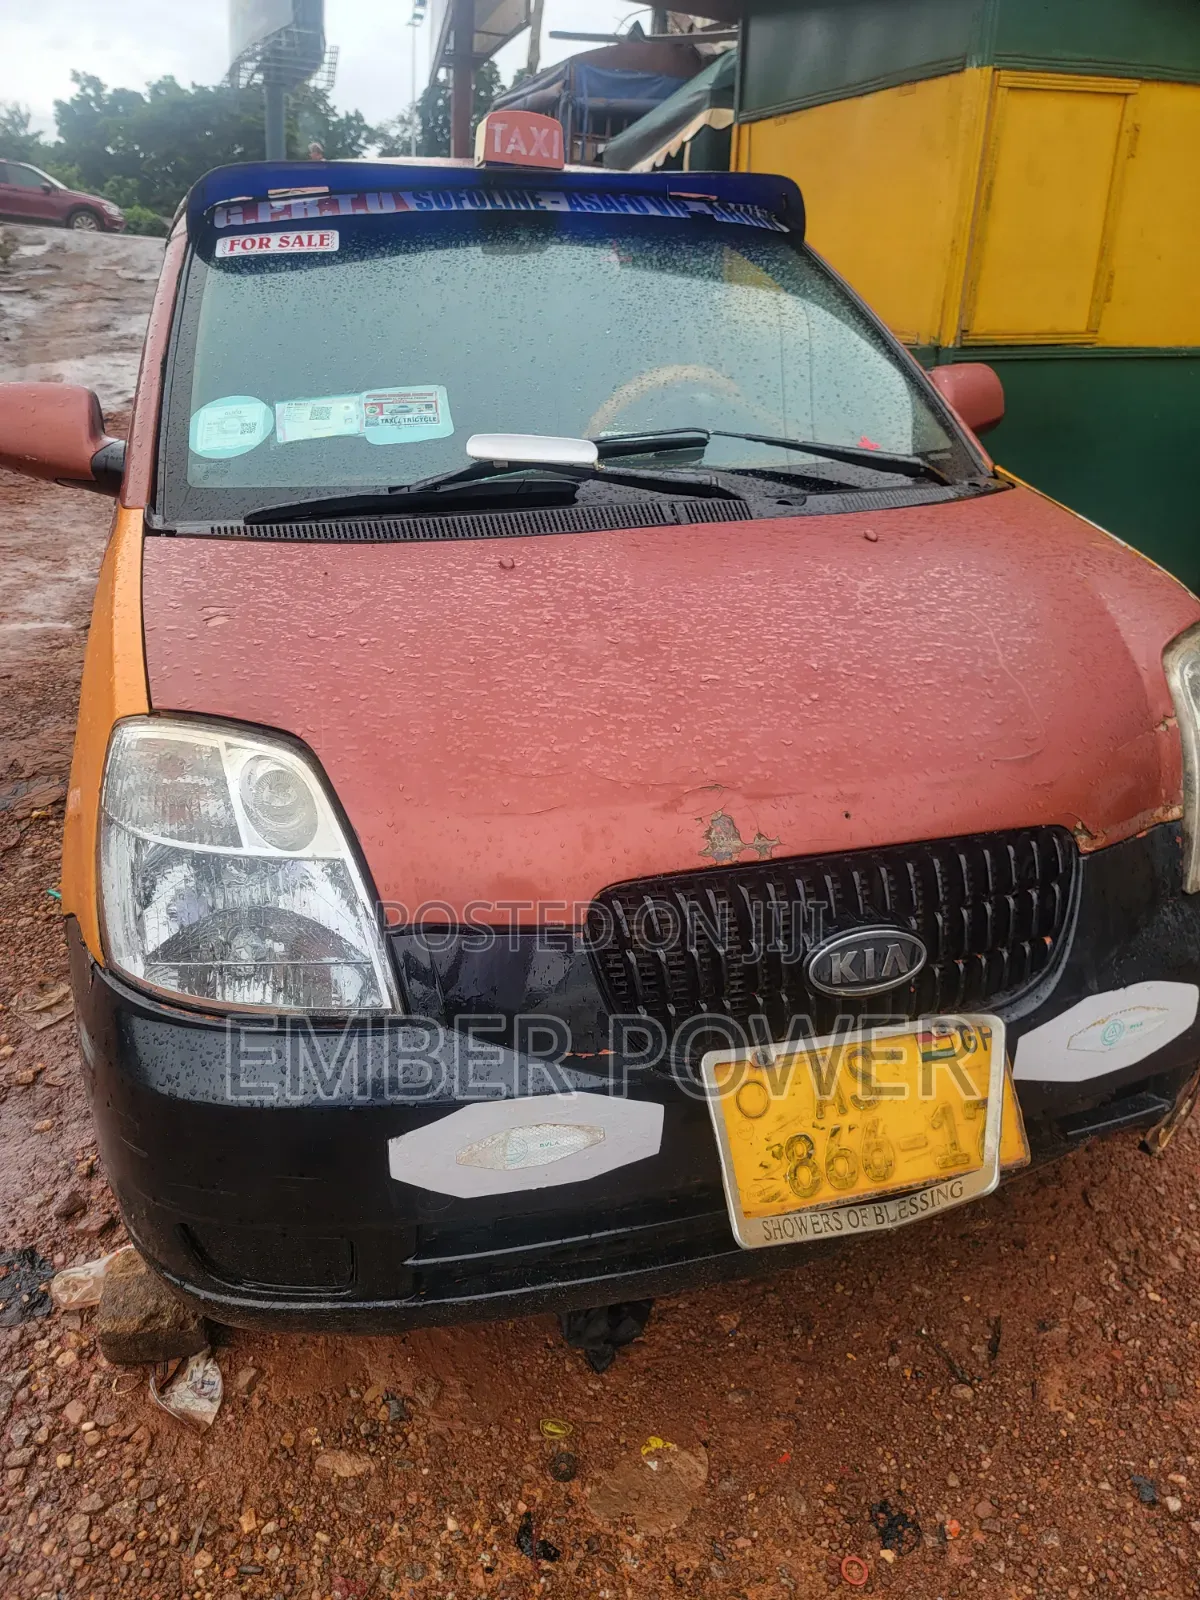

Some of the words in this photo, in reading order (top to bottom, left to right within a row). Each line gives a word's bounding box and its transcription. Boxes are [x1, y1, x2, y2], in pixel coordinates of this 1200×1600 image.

[489, 123, 560, 160] TAXI
[228, 236, 272, 252] FOR
[278, 234, 331, 249] SALE
[829, 943, 909, 985] KIA
[762, 1211, 843, 1242] SHOWERS
[847, 1207, 869, 1229] OF
[874, 1180, 964, 1225] BLESSING
